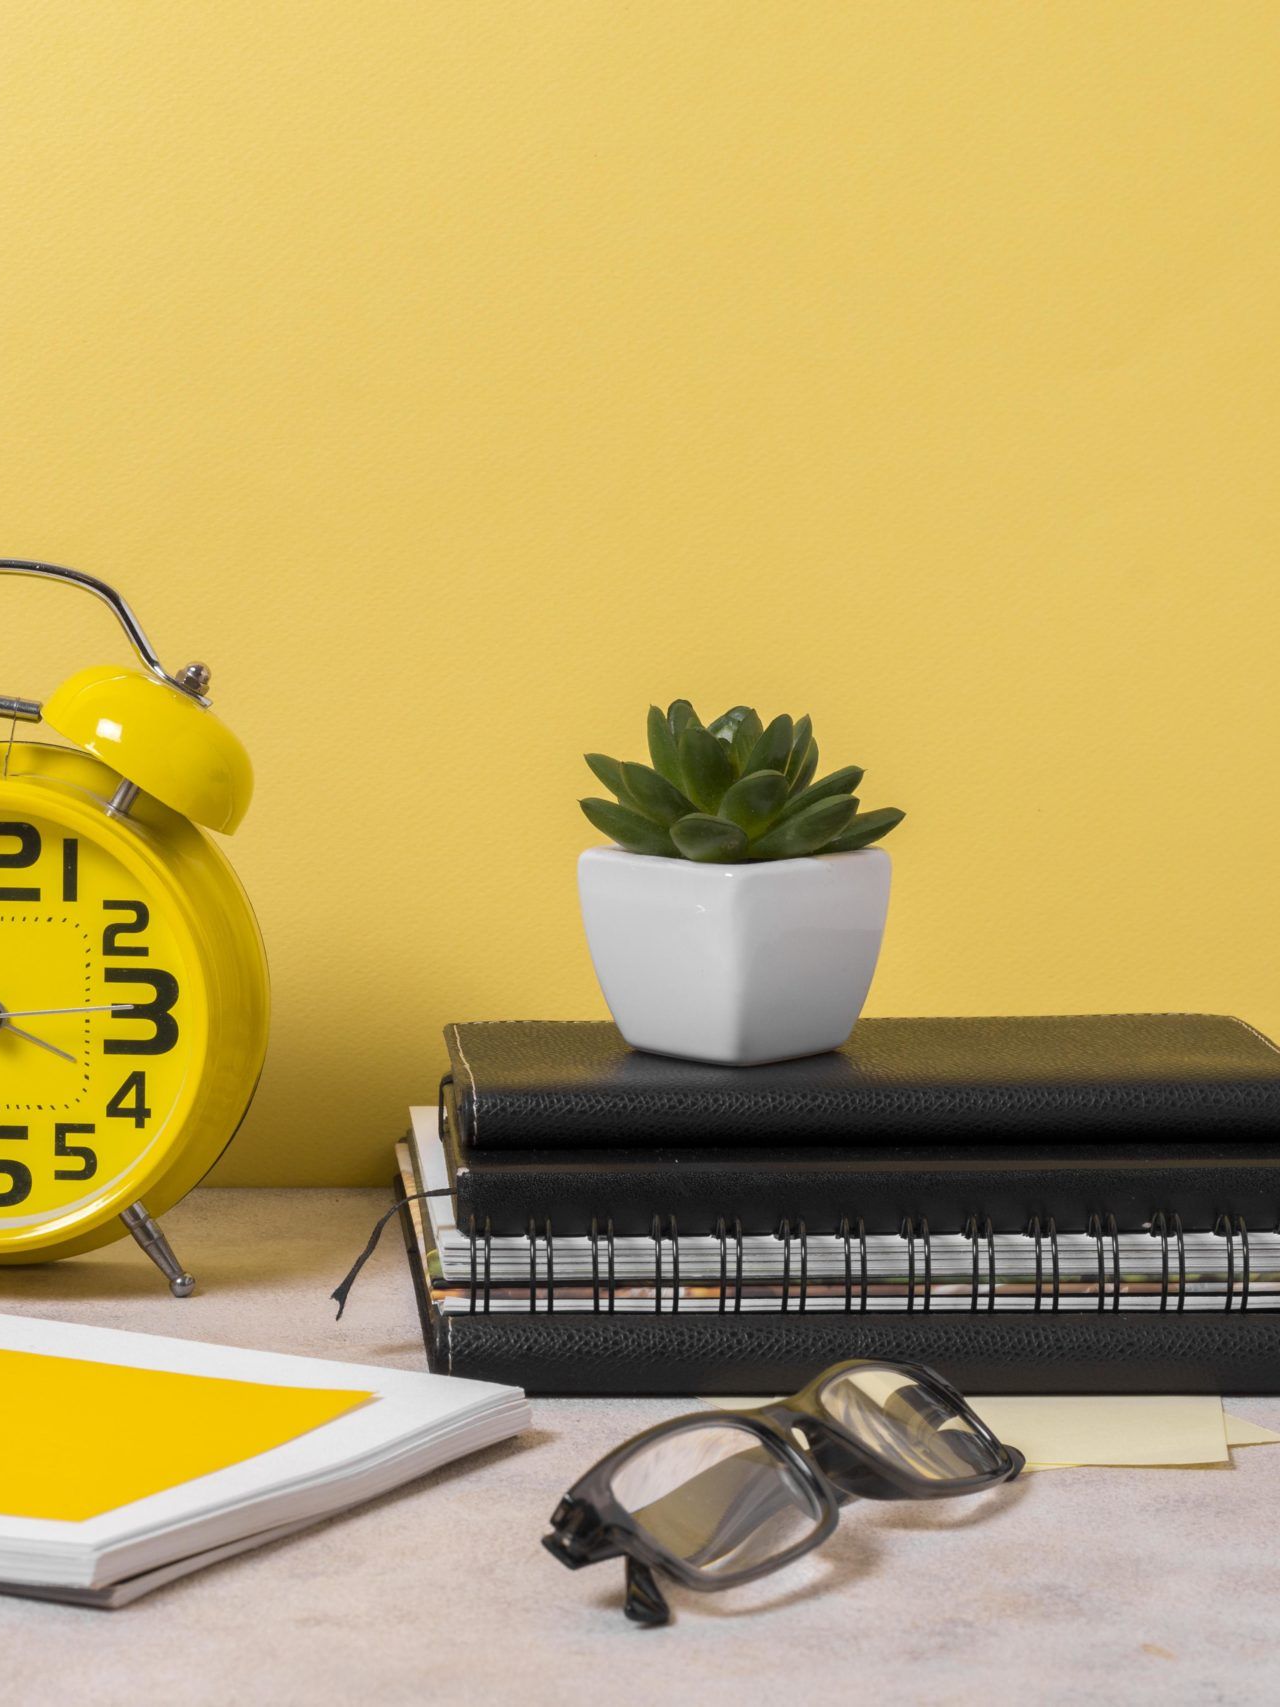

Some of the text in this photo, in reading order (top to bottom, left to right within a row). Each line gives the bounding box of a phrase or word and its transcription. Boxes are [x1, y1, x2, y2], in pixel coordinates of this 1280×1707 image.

[62, 838, 78, 902] 1
[102, 900, 150, 957] 2
[103, 967, 180, 1056] 3
[106, 1071, 152, 1129] 4
[54, 1123, 98, 1181] 5
